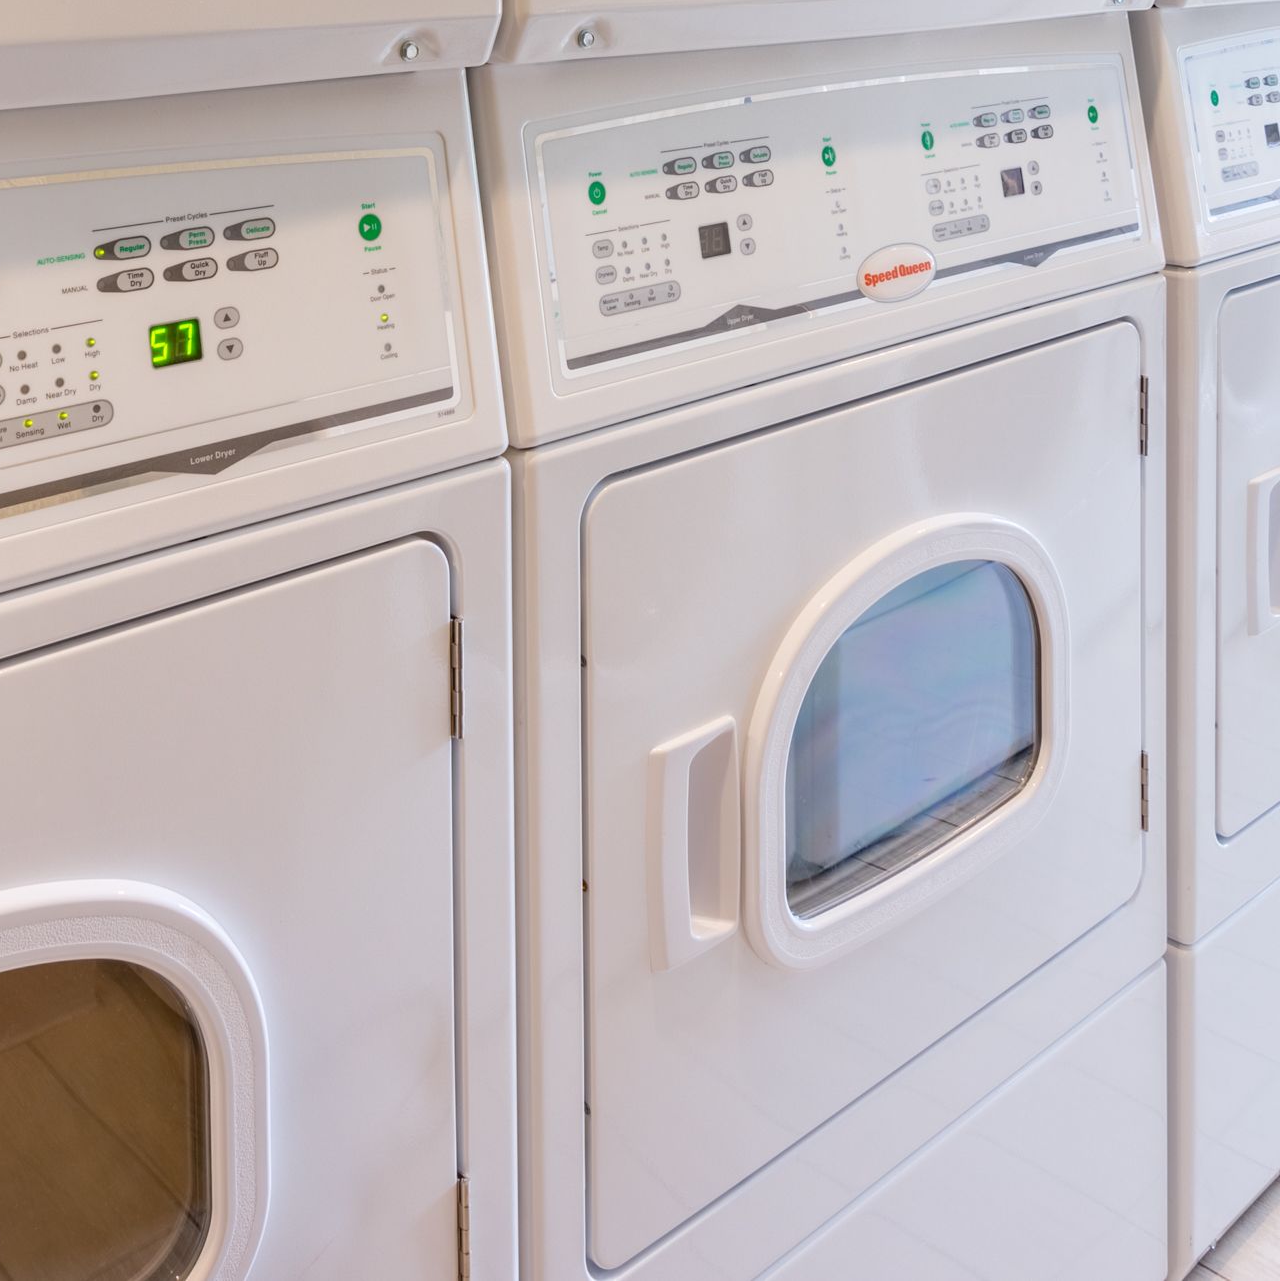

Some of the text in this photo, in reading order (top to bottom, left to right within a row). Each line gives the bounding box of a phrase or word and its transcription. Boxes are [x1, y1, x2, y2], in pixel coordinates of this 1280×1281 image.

[361, 202, 376, 210] Start
[165, 211, 208, 223] Preset Cycles
[245, 225, 270, 234] Delicate
[188, 230, 206, 239] Perm
[188, 238, 207, 246] Press
[119, 242, 146, 253] Regular
[36, 252, 85, 266] AUTO-SENSING
[254, 251, 269, 260] Fluff
[190, 261, 209, 270] Quick
[257, 259, 267, 267] Up
[127, 271, 144, 280] Time
[194, 268, 207, 277] Dry
[864, 261, 931, 287] Speed Queen
[130, 279, 143, 287] Dry
[61, 285, 88, 295] MANUAL
[12, 327, 49, 339] Selections
[150, 323, 193, 363] 57
[85, 349, 100, 359] High
[51, 356, 65, 365] Low
[9, 361, 39, 373] No Heat
[89, 382, 102, 391] Dry
[46, 387, 77, 400] Near Dry
[16, 396, 37, 406] Damp
[92, 414, 104, 423] Dry
[57, 421, 72, 430] Wet
[16, 426, 45, 439] Sensing
[190, 448, 236, 465] Lower Dryer
